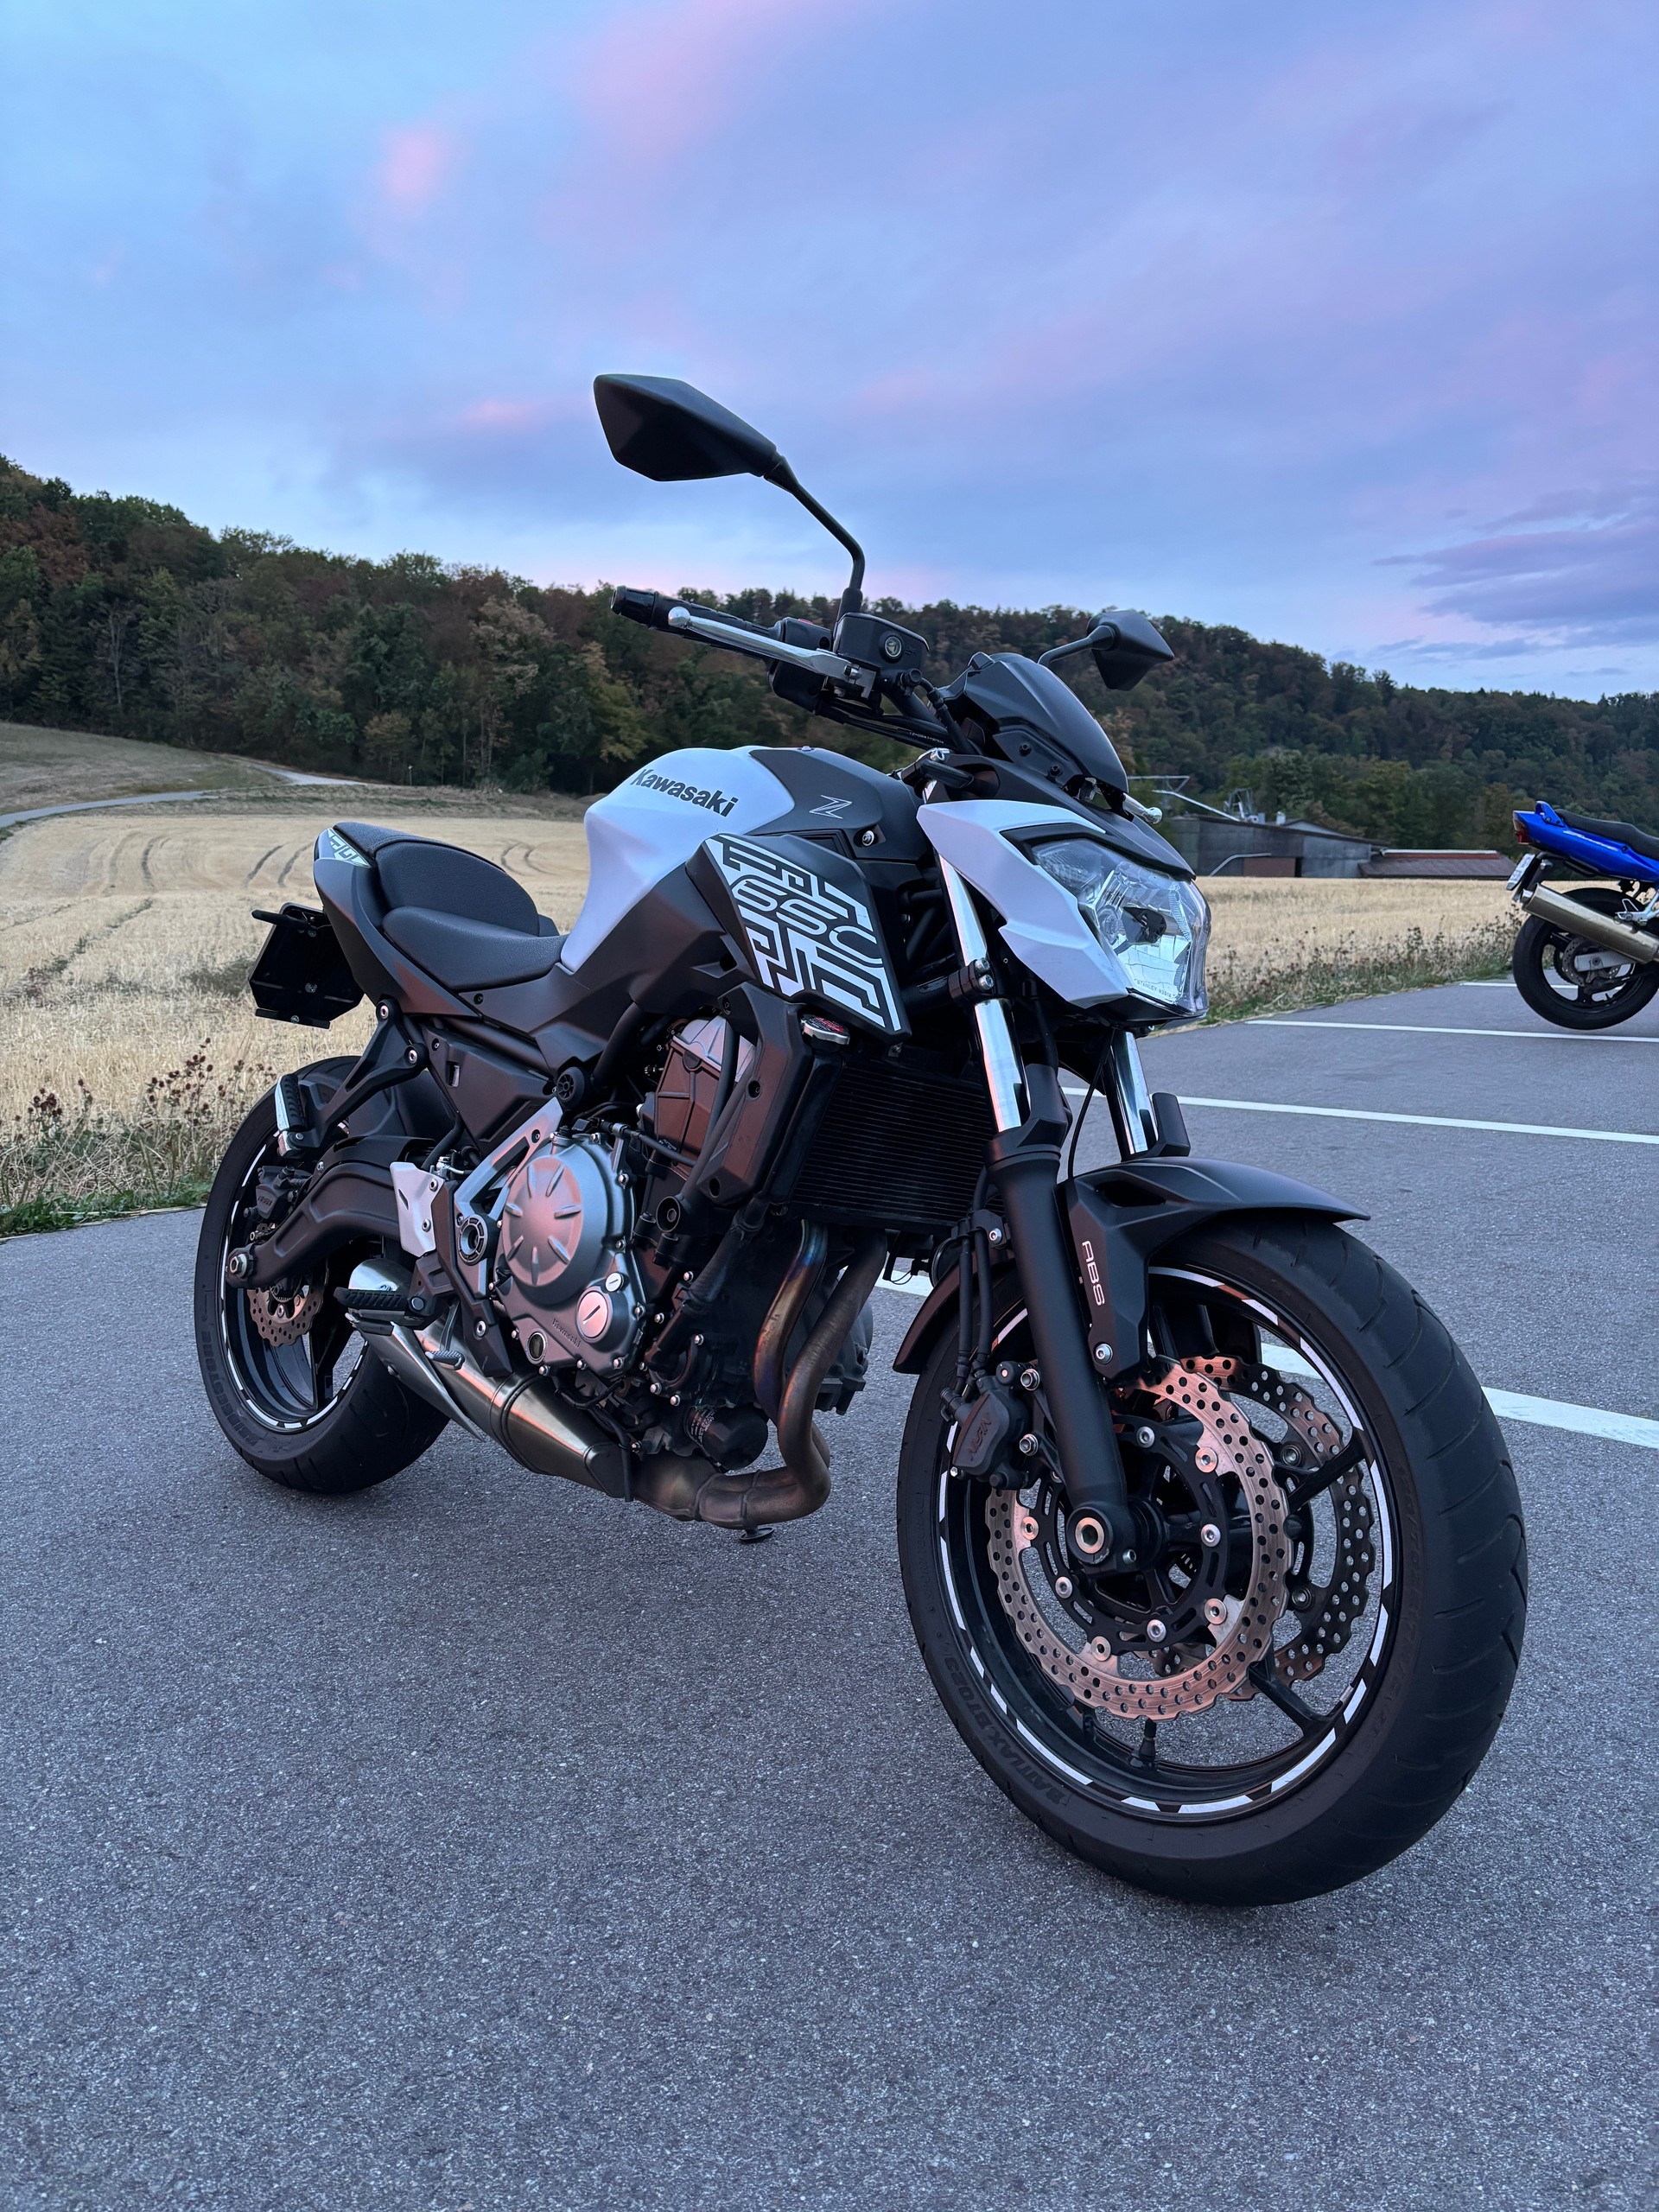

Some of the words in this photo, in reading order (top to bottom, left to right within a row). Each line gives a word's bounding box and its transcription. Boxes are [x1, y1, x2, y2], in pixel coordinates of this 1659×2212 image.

[630, 769, 739, 817] Kawasaki
[1082, 1241, 1105, 1306] ABS
[553, 1318, 582, 1348] Kawasaki
